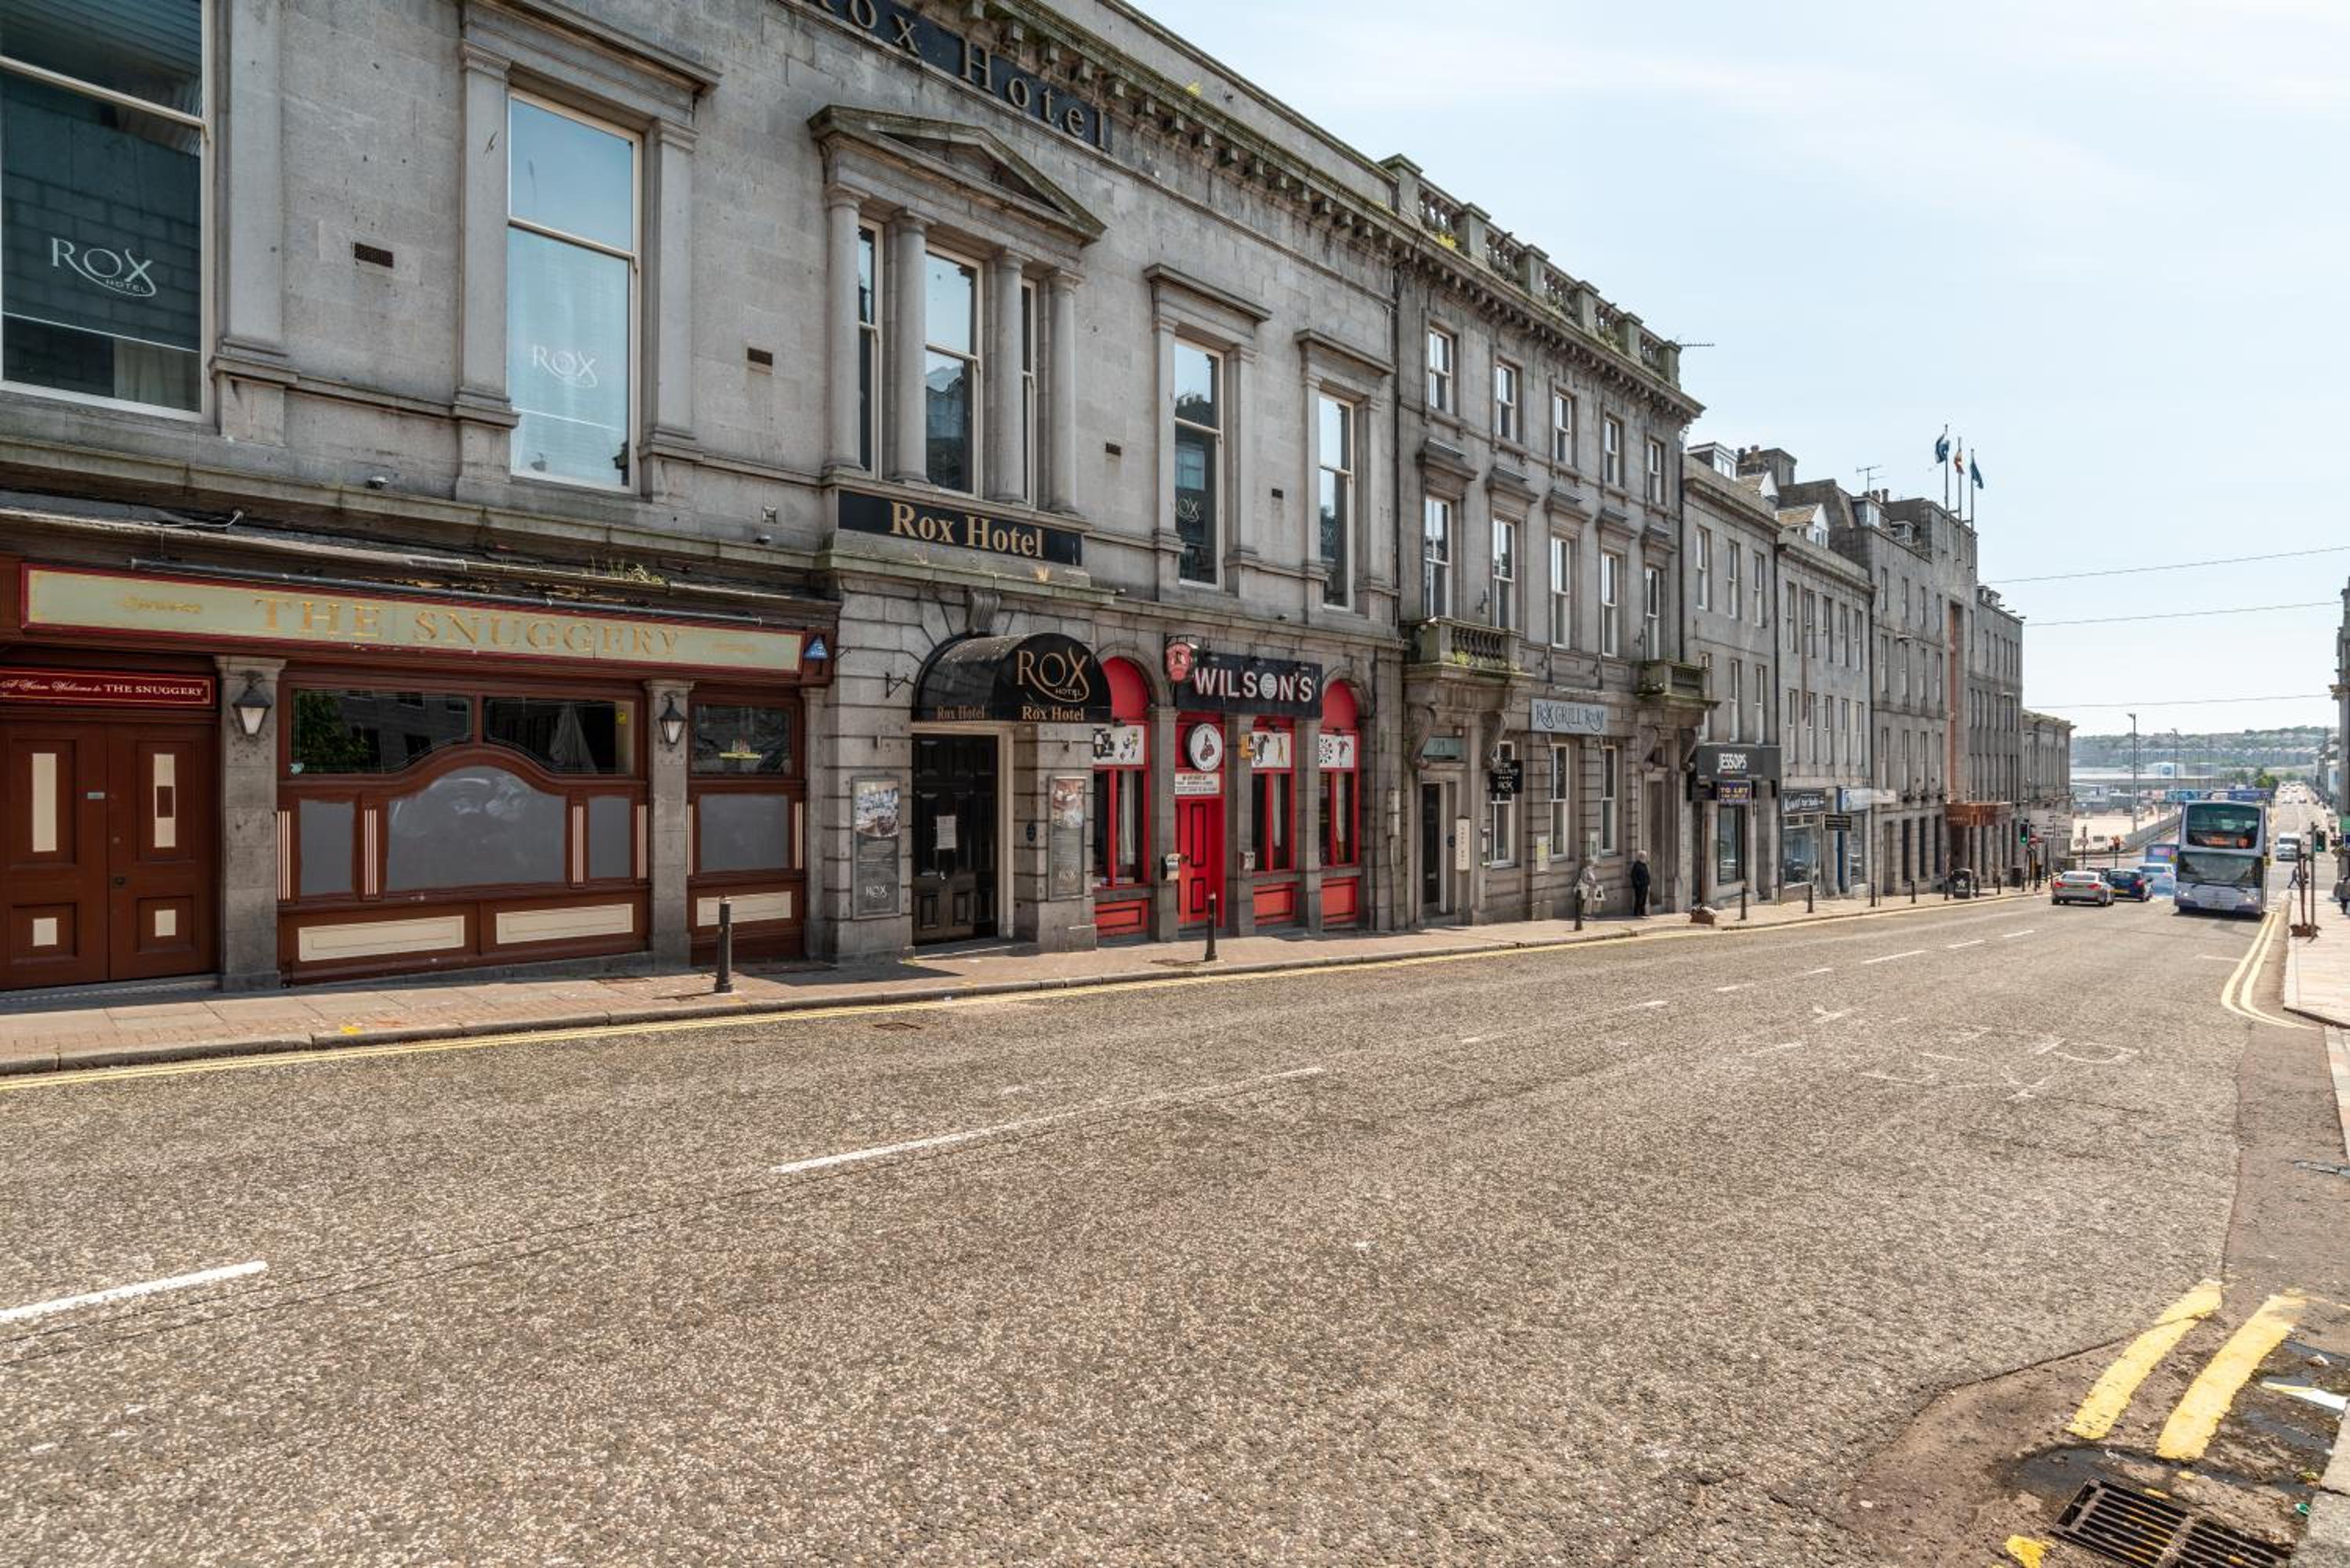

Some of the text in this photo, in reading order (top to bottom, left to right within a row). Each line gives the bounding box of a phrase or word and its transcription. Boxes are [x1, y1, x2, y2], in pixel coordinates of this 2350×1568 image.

[958, 36, 1112, 154] Hotel
[51, 237, 157, 297] ROX
[106, 279, 148, 294] HOTEL
[533, 345, 598, 388] ROX
[890, 501, 1043, 558] Rox Hotel
[253, 598, 381, 638] THE
[413, 609, 682, 657] SNUGGERY
[103, 684, 132, 694] THE
[135, 685, 204, 696] SNUGGERY
[1017, 645, 1090, 703] ROX
[1055, 688, 1083, 696] HOTEL
[1194, 667, 1313, 703] WILSON'S
[937, 705, 985, 719] Rox Hotel
[1021, 706, 1086, 721] Rox Hotel
